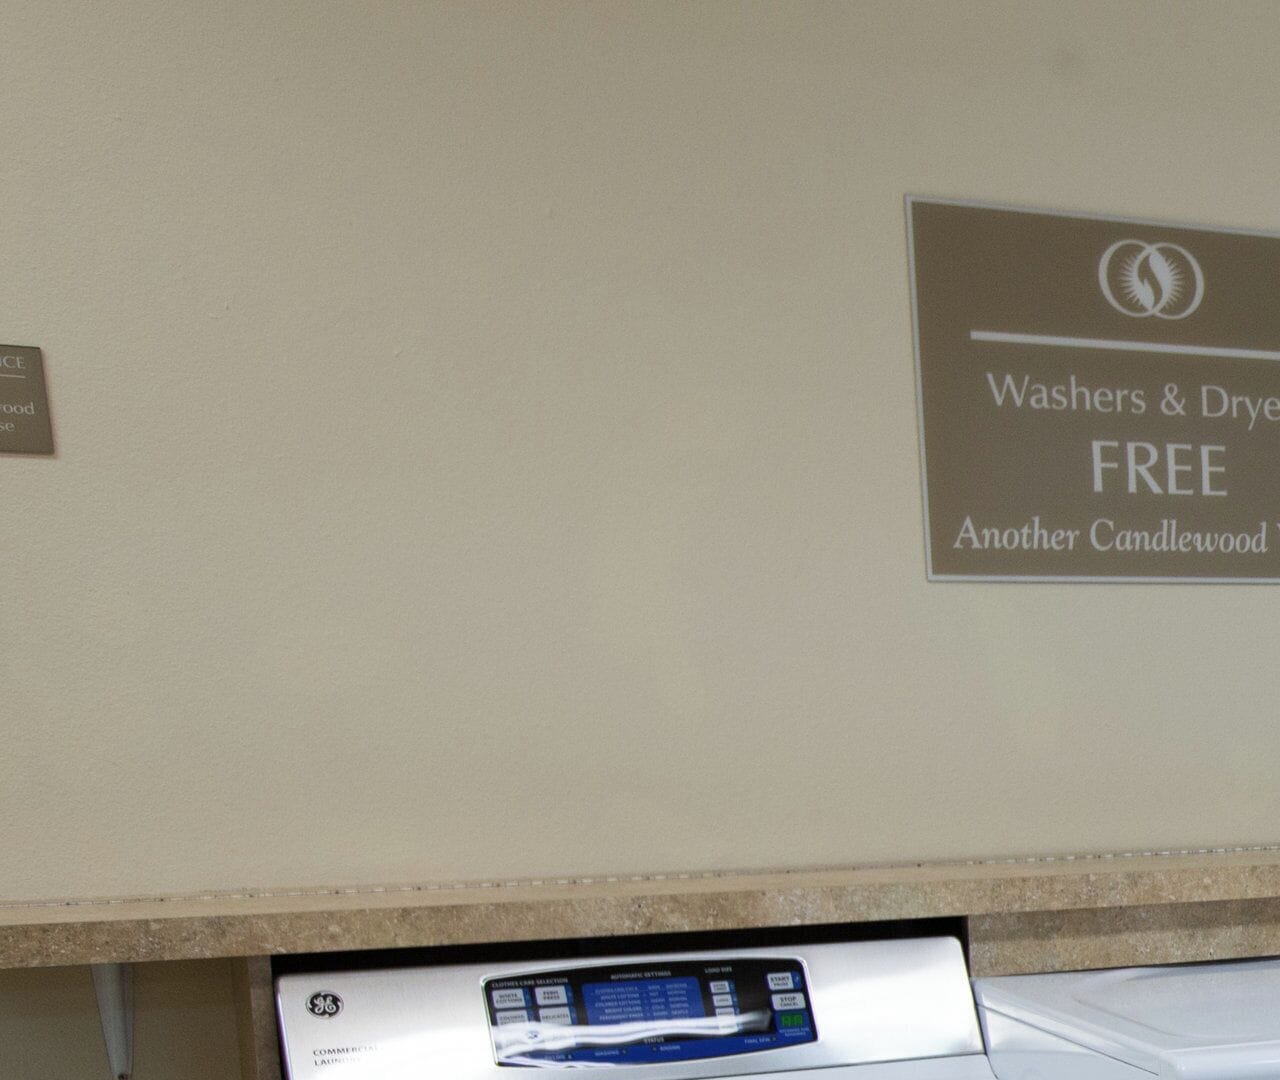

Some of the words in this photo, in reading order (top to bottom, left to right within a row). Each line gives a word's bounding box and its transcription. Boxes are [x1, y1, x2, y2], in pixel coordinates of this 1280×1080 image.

[0, 356, 26, 369] CE
[986, 373, 1146, 414] Washers
[1160, 383, 1186, 416] &
[0, 402, 35, 415] ood
[1092, 440, 1228, 496] FREE
[953, 515, 1081, 550] Another
[1090, 518, 1269, 553] Candlewood
[536, 977, 569, 985] SELECTION
